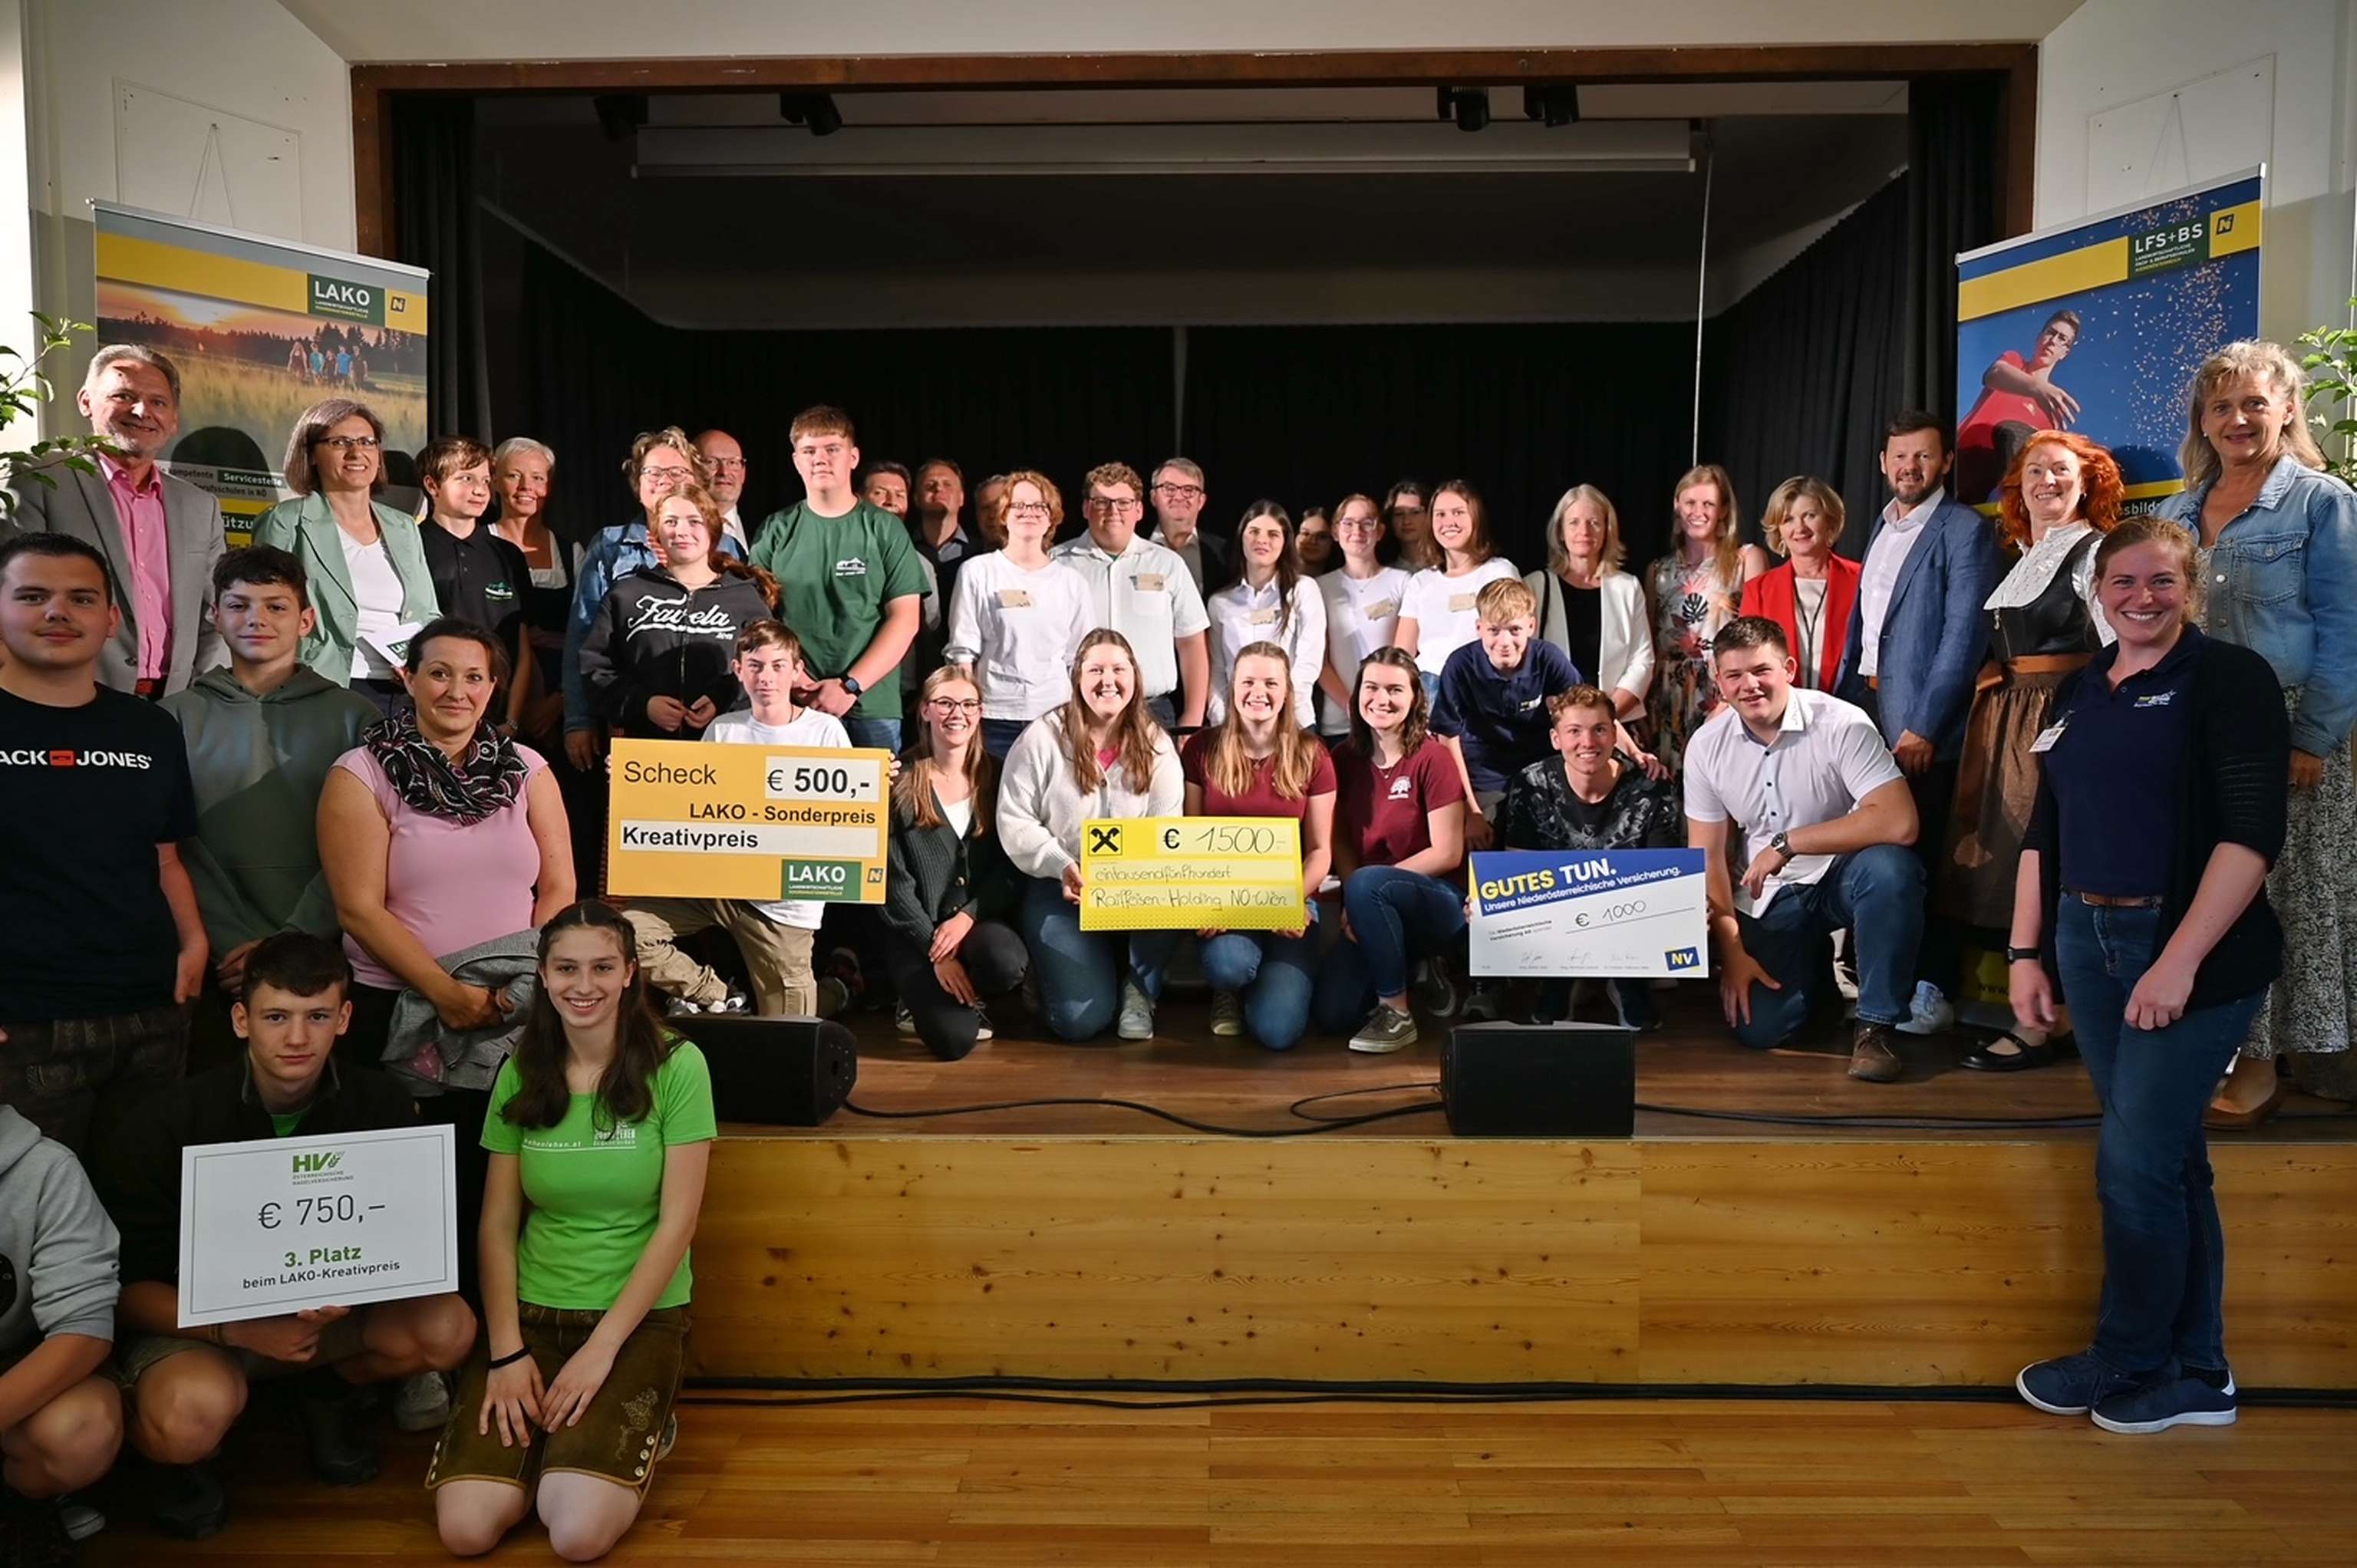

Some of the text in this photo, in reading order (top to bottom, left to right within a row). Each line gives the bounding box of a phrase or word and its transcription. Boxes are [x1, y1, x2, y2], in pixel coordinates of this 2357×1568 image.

[2135, 223, 2203, 253] LFS+BS
[315, 281, 370, 306] LAKO
[223, 473, 282, 486] Servicestelle
[2123, 500, 2160, 516] sbild
[628, 594, 730, 628] Favela
[76, 750, 151, 769] JONES
[624, 761, 717, 786] Scheck
[766, 767, 870, 798] € 500,-
[690, 803, 746, 820] LAKO
[764, 805, 876, 826] Sonderpreis
[623, 826, 758, 851] Kreativpreis
[1163, 828, 1180, 849] €
[789, 865, 846, 883] LAKO
[1481, 858, 1617, 900] GUTES TUN.
[1484, 866, 1681, 912] Unsere Niederösterreichische Versicherung.
[1575, 901, 1647, 927] € 1000
[1671, 952, 1694, 966] NV
[292, 1152, 332, 1172] HV
[258, 1202, 282, 1229] €
[285, 1247, 361, 1267] 3. Platz
[242, 1260, 400, 1289] beim LAKO-Kreativpreis
